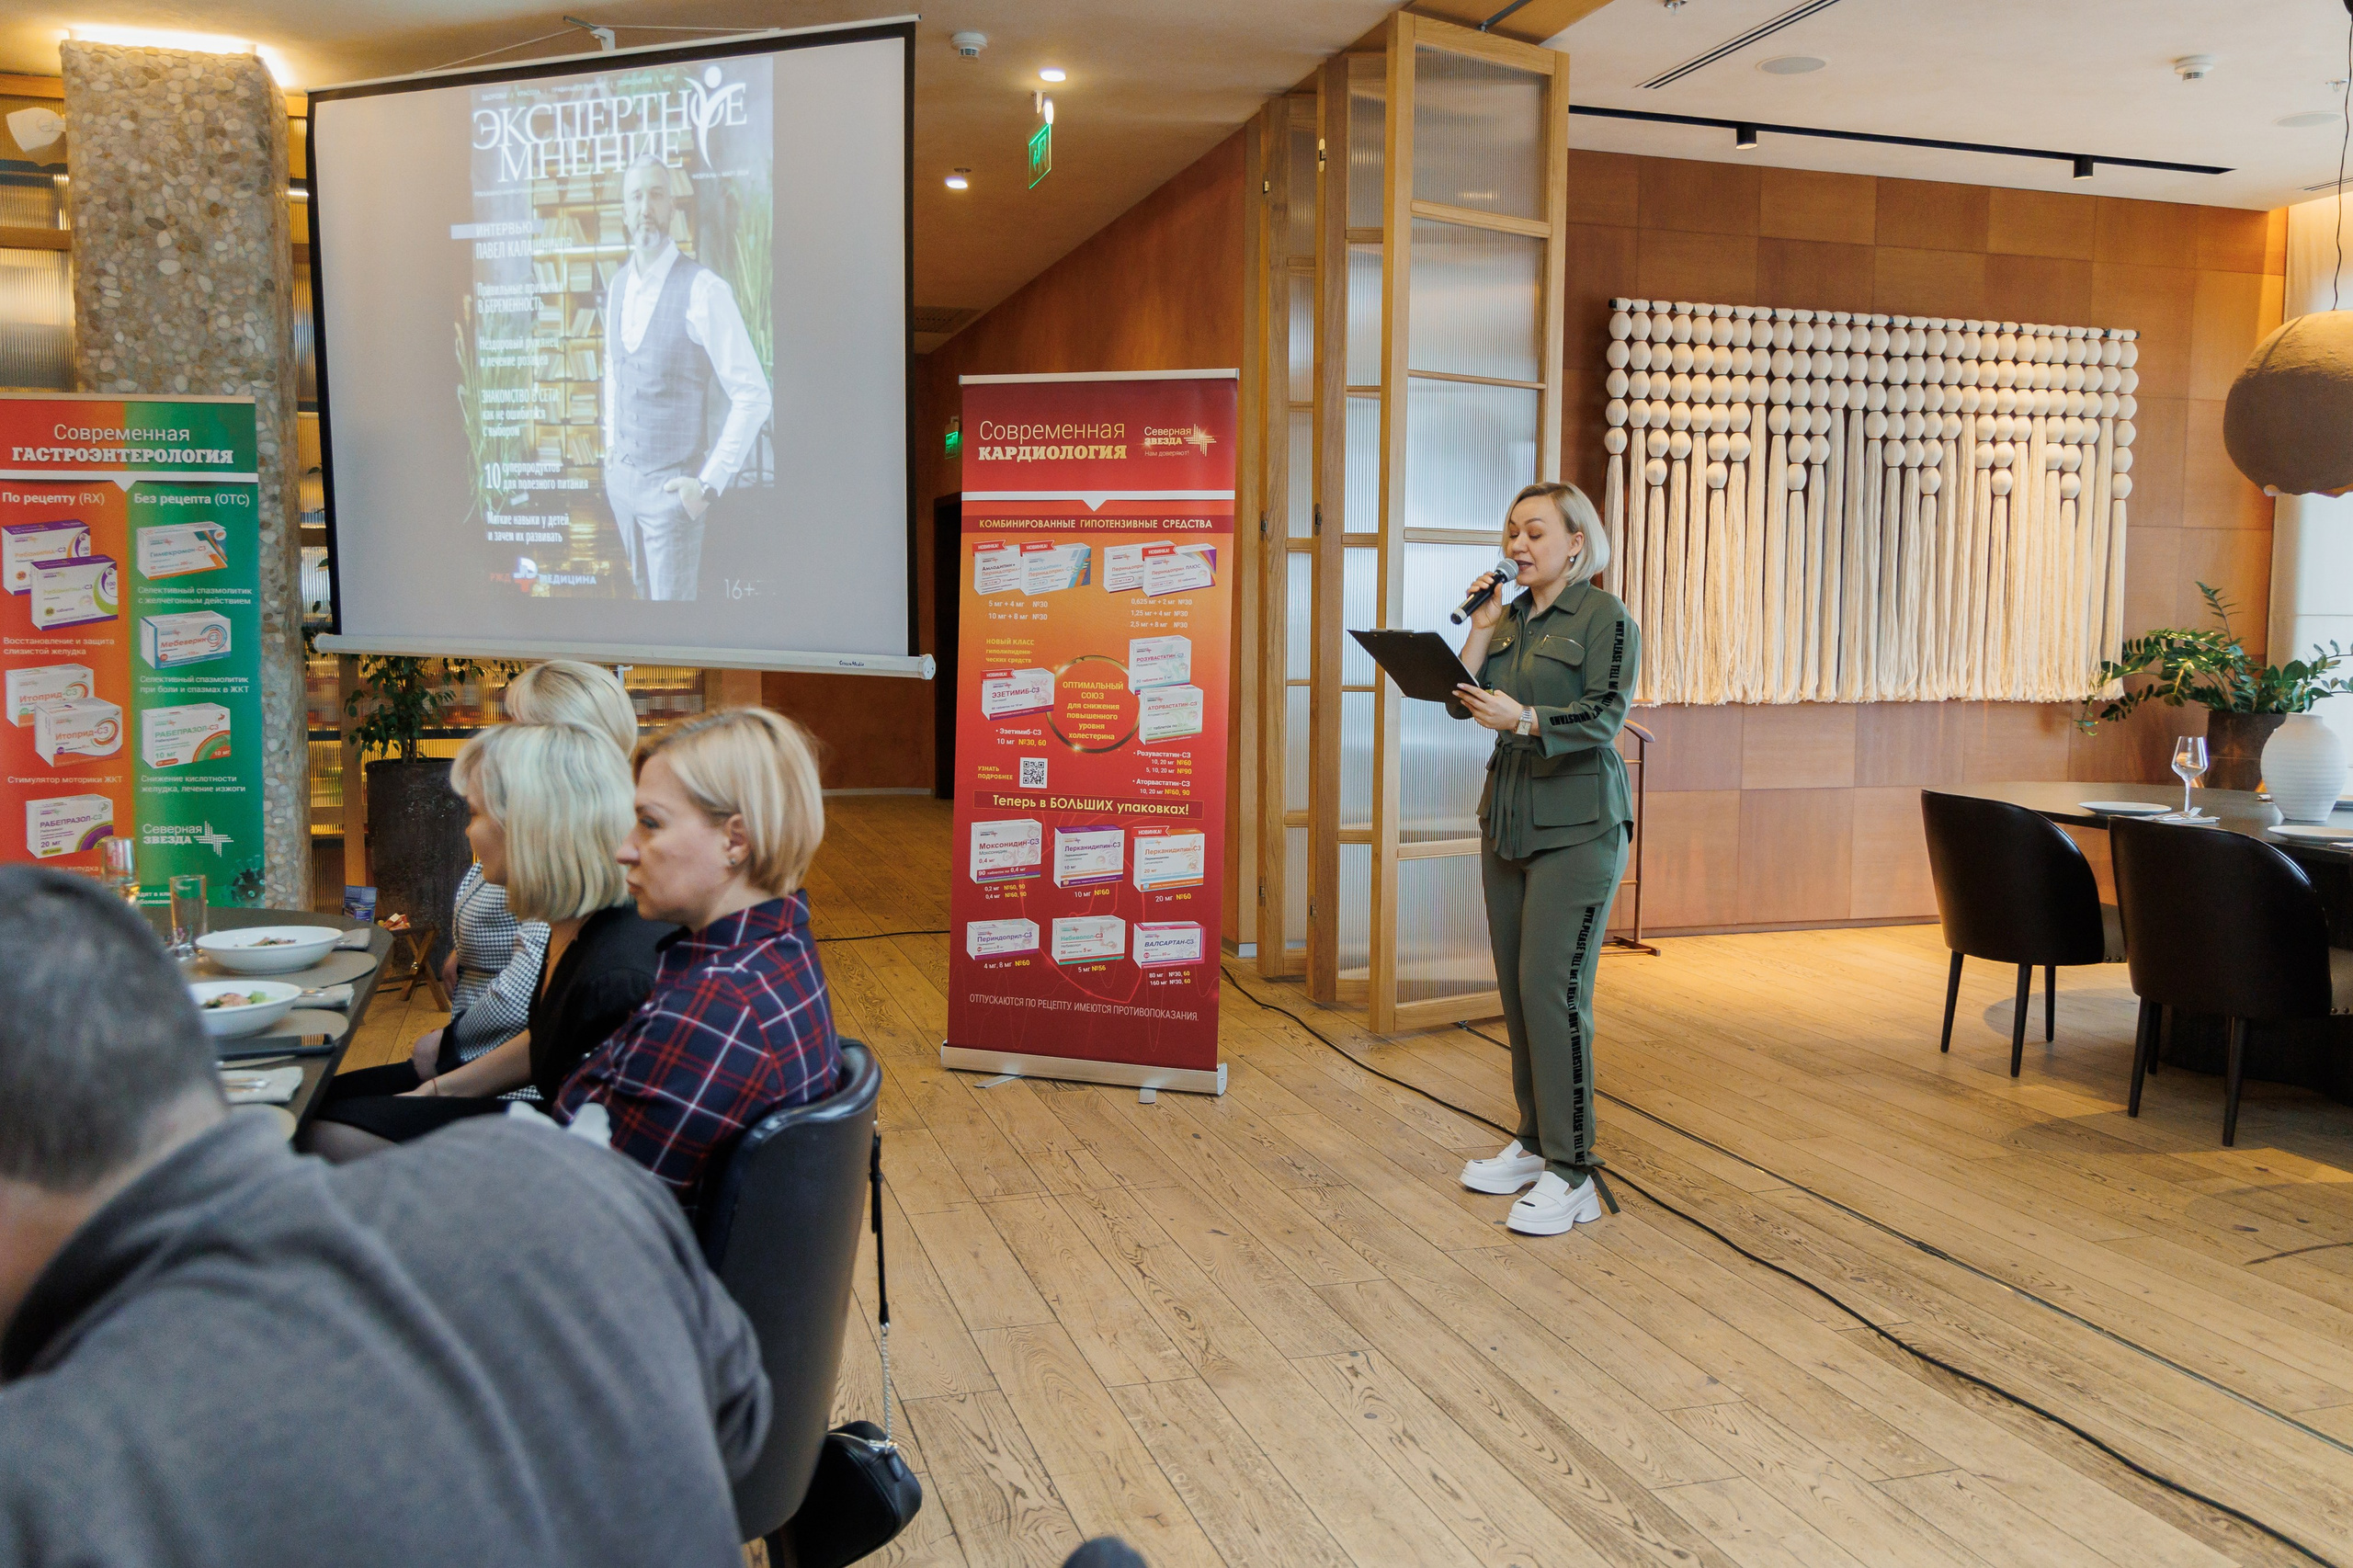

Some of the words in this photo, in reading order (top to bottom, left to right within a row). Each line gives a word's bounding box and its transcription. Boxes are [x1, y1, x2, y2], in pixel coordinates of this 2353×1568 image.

[497, 128, 684, 183] МНЕНИЕ
[476, 222, 533, 236] ИНТЕРВЬЮ
[476, 242, 505, 259] ПАВЕЛ
[478, 282, 523, 299] Правильные
[478, 300, 483, 313] В
[484, 297, 543, 312] БЕРЕМЕННОСТЬ
[480, 336, 524, 353] Нездоровый
[487, 357, 516, 367] лечение
[482, 389, 529, 403] ЗНАКОМСТВО
[483, 410, 494, 420] как
[495, 410, 504, 419] не
[54, 425, 190, 444] Современная
[489, 426, 519, 439] выбором
[980, 421, 1125, 444] Современная
[1144, 426, 1191, 437] Северная
[13, 448, 233, 463] ГАСТРОЭНТЕРОЛОГИЯ
[978, 445, 1127, 462] КАРДИОЛОГИЯ
[485, 462, 501, 489] 10
[503, 463, 561, 476] суперпродуктов
[503, 481, 517, 491] для
[518, 481, 555, 489] полезного
[558, 480, 588, 489] питания
[2, 493, 19, 504] По
[24, 494, 75, 506] рецепту
[79, 494, 105, 505] (RX)
[134, 494, 156, 504] Без
[161, 494, 210, 506] рецепта
[487, 511, 512, 526] Мягкие
[514, 515, 540, 526] навыки
[542, 516, 546, 528] у
[549, 514, 569, 528] детей
[980, 519, 1075, 528] КОМБИНИРОВАННЫЕ
[1081, 519, 1157, 528] ГИПОТЕНЗИВНЫЕ
[1163, 519, 1212, 528] СРЕДСТВА
[488, 532, 493, 541] и
[494, 532, 515, 541] зачем
[517, 532, 524, 541] их
[526, 532, 563, 544] развивать
[538, 574, 597, 585] МЕДИЦИНА
[138, 586, 194, 595] Селективный
[725, 579, 755, 599] 16+
[1609, 665, 1620, 678] TELL
[1063, 681, 1123, 690] ОПТИМАЛЬНЫЙ
[19, 689, 77, 703] Итоприд-СЗ
[992, 687, 1040, 698] ЭЗЕТИМИБ-СЗ
[1148, 701, 1198, 711] АТОРВАСТАТИН-СЗ
[1067, 712, 1118, 721] повышенного
[56, 727, 108, 741] Итоприд-СЗ
[155, 724, 219, 737] РАБЕПРАЗОЛ-СЗ
[1069, 733, 1115, 741] холестерина
[1137, 750, 1190, 758] Розувастатин-СЗ
[1136, 778, 1190, 787] Аторвастатин-СЗ
[994, 795, 1036, 809] Теперь
[1040, 800, 1046, 808] в
[1050, 798, 1113, 811] БОЛЬШИХ
[1117, 803, 1189, 815] упаковках!
[40, 814, 102, 827] РАБЕПРАЗОЛ-СЗ
[142, 824, 202, 835] Северная
[143, 836, 192, 845] ЗВЕЗДА
[979, 838, 1040, 850] Моксонидин-СЗ
[1064, 842, 1121, 852] Лерканидипин-СЗ
[1145, 846, 1200, 855] Лерканидипин-СЗ
[977, 932, 1032, 943] Периндоприл-СЗ
[1571, 952, 1585, 966] TELL
[1569, 969, 1578, 980] ME
[1567, 987, 1576, 1011] REALLY
[970, 994, 1023, 1006] ОТПУСКАЮТСЯ
[1026, 999, 1036, 1007] ПО
[1038, 1000, 1072, 1011] РЕЦЕПТУ.
[1074, 1003, 1112, 1014] ИМЕЮТСЯ
[1113, 1006, 1199, 1021] ПРОТИВОПОКАЗАНИЯ.
[1568, 1013, 1580, 1034] DON'T
[1571, 1035, 1583, 1085] UNDERSTAND
[1574, 1133, 1584, 1150] TELL
[1574, 1151, 1585, 1164] ME
